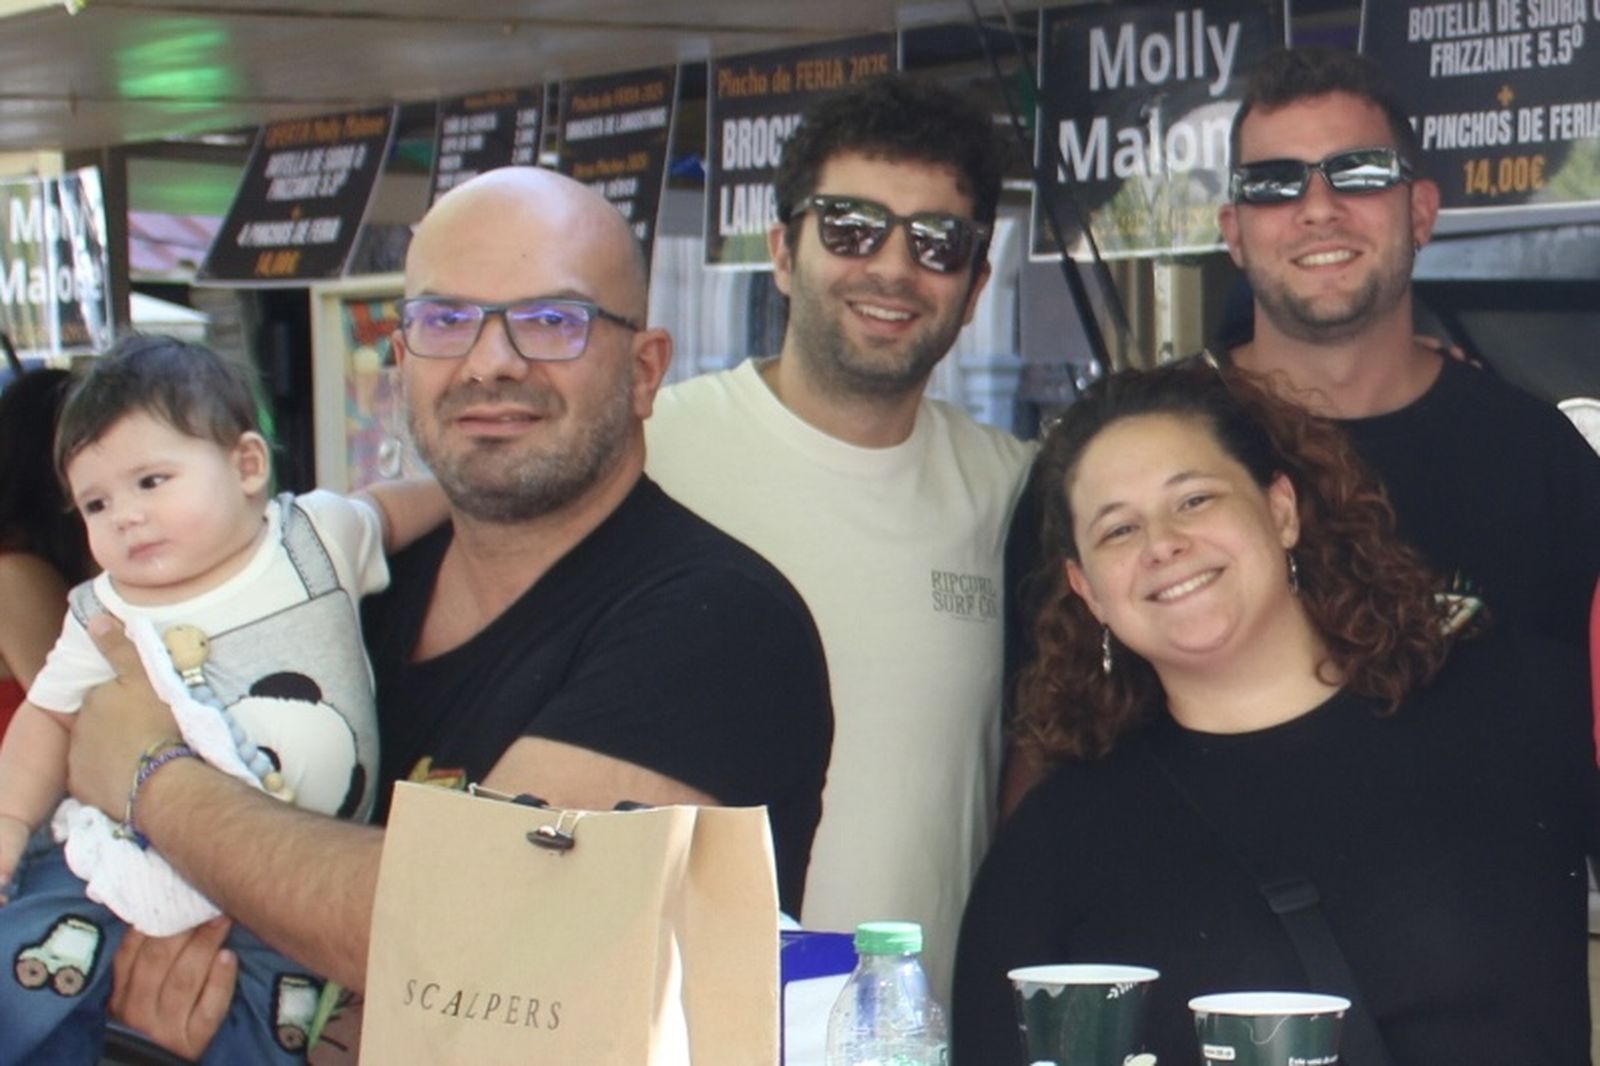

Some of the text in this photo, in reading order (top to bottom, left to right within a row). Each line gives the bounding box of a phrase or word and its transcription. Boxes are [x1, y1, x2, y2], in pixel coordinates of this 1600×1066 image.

[1408, 2, 1491, 42] BOTELLA
[1497, 0, 1521, 32] DE
[1527, 0, 1587, 29] SIDRA
[1089, 9, 1241, 96] Molly
[1430, 32, 1532, 77] FRIZZANTE
[717, 68, 767, 97] Pincho
[772, 64, 790, 93] de
[795, 58, 844, 91] FERIA
[1423, 109, 1512, 150] PINCHOS
[1518, 106, 1544, 143] DE
[1464, 155, 1546, 197] 14,00€
[931, 590, 975, 615] SURF
[403, 978, 562, 1031] SCALPERS
